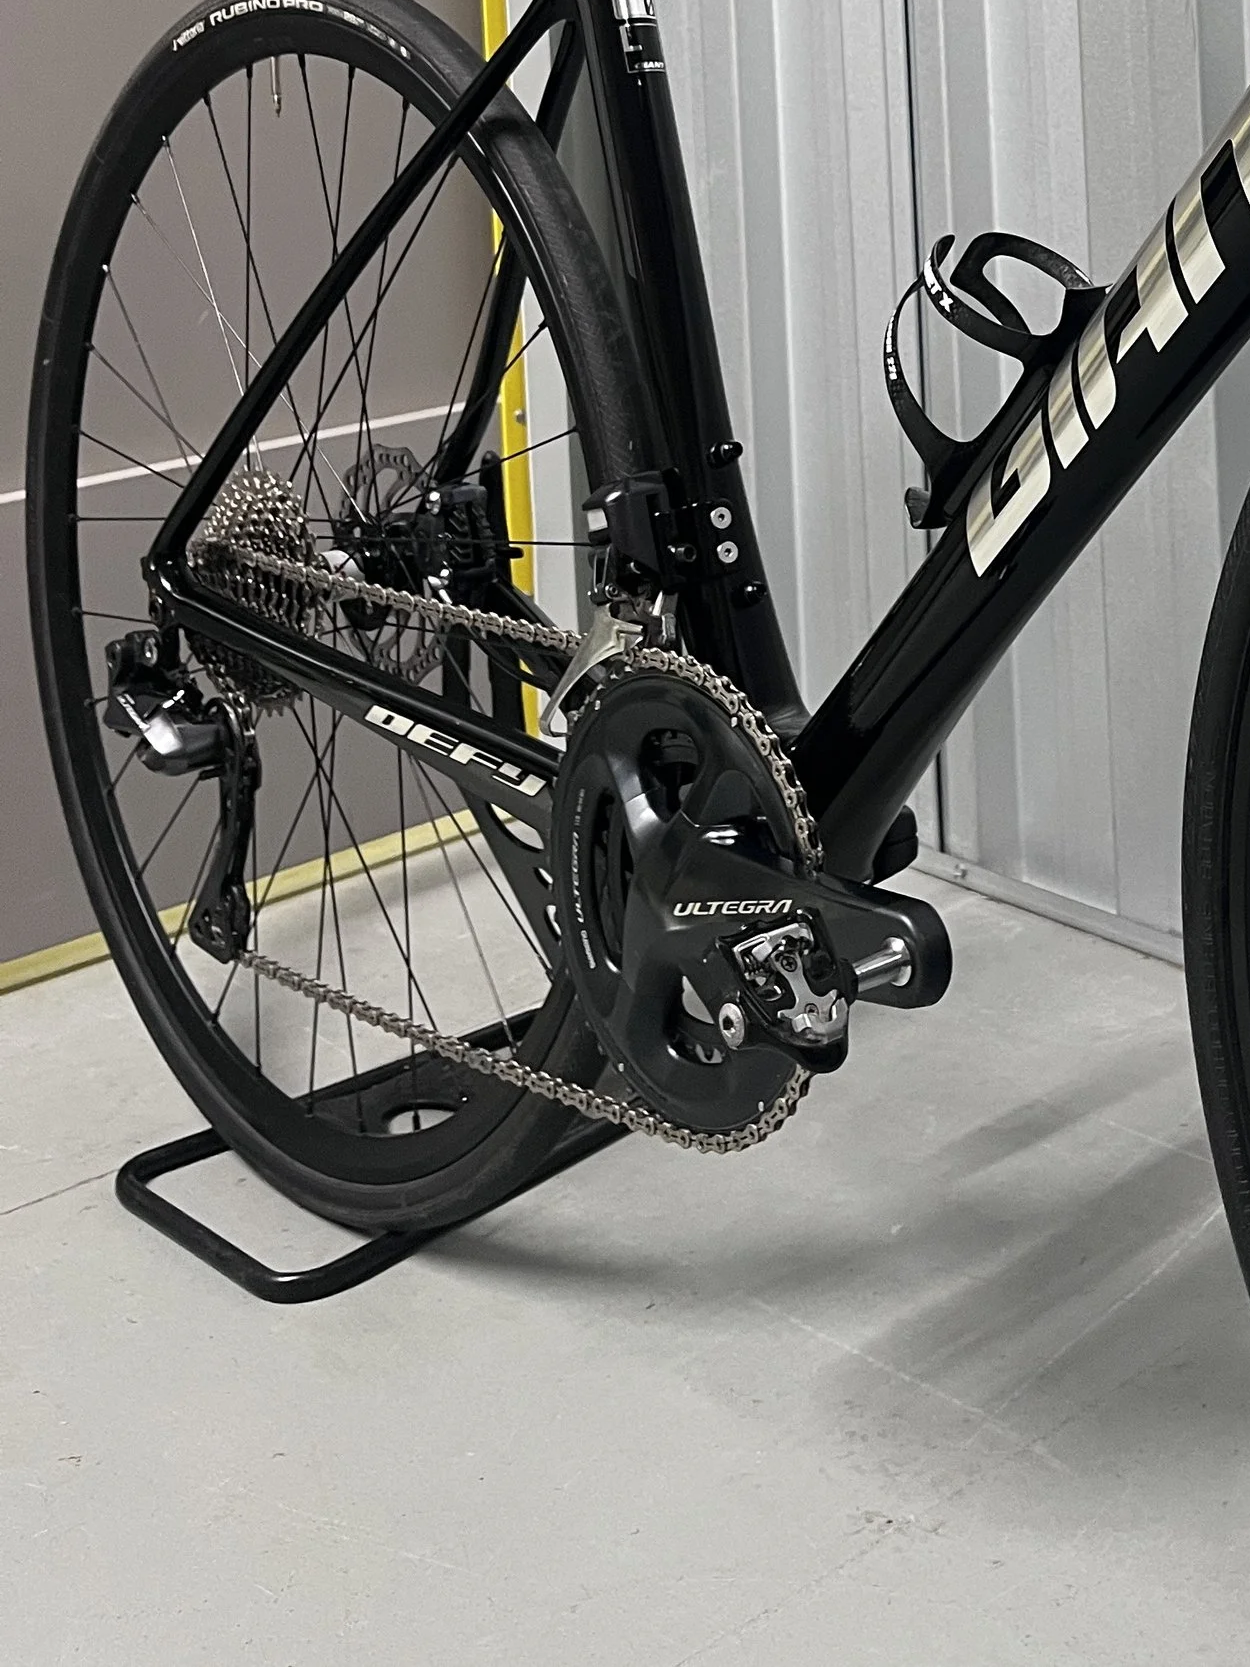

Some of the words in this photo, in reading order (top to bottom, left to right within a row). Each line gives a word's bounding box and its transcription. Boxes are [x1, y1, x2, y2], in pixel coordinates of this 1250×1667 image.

[364, 705, 547, 797] DEFY
[571, 831, 585, 924] ULTEGRA
[673, 898, 793, 916] ULTEGRA
